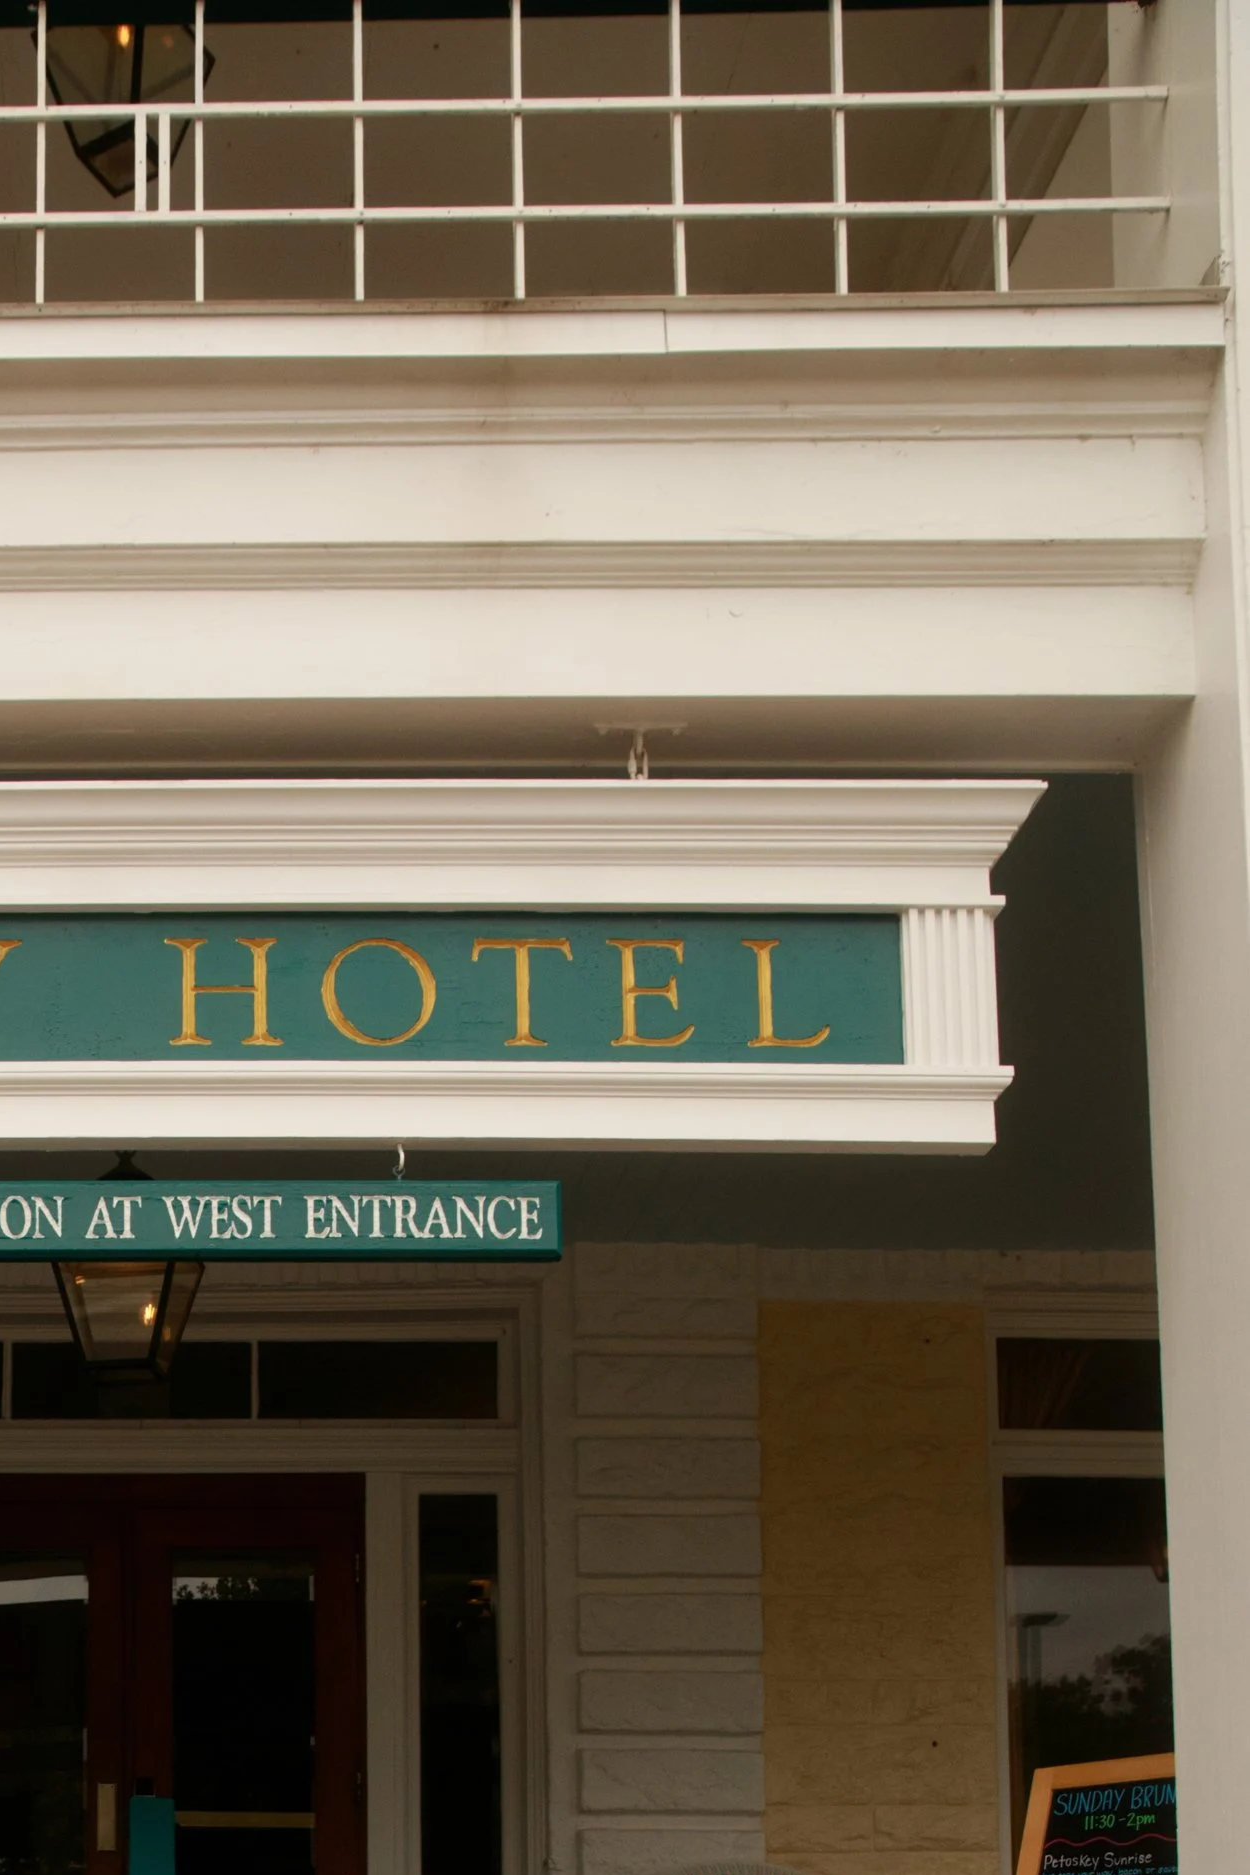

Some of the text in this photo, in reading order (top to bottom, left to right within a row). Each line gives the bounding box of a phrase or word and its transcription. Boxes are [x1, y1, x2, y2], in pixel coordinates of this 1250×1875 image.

[164, 937, 831, 1048] HOTEL
[86, 1195, 143, 1242] AT
[163, 1194, 283, 1241] WEST
[304, 1194, 545, 1241] ENTRANCE
[1054, 1788, 1126, 1816] SUNDAY
[1105, 1852, 1152, 1866] Sunrise
